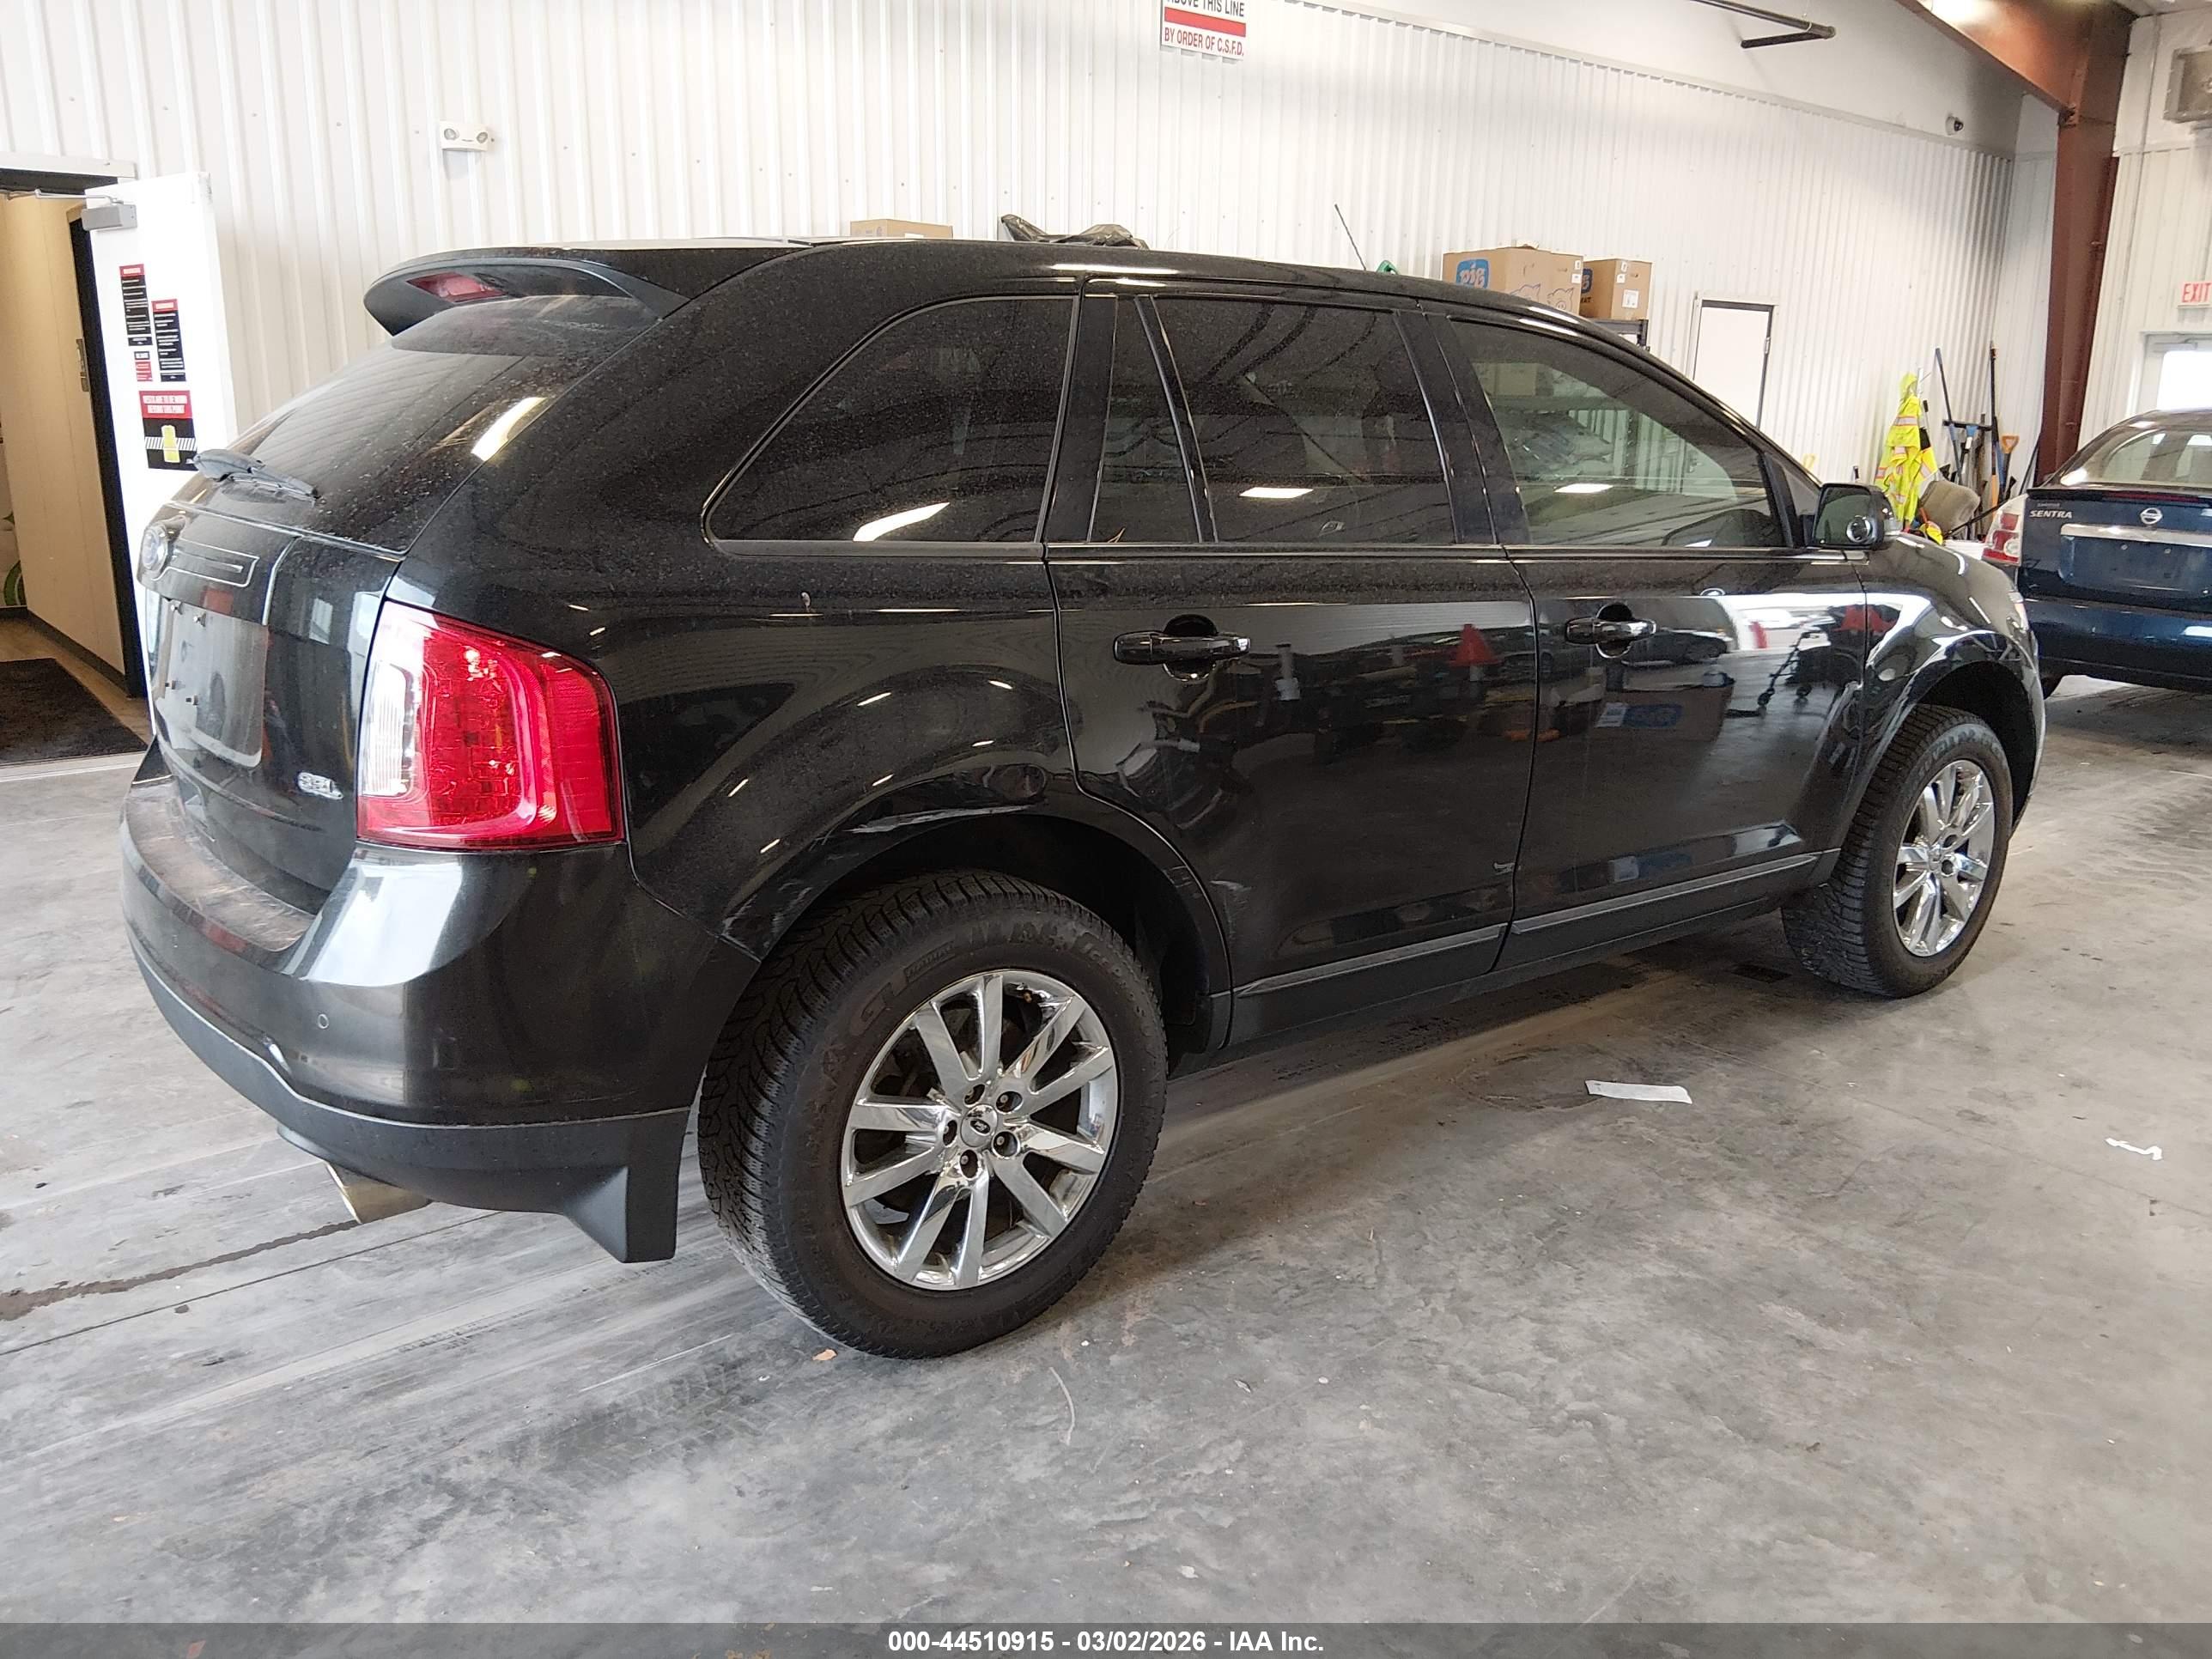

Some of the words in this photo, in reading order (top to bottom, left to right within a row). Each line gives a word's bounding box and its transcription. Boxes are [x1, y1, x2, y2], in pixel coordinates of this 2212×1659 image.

[1203, 0, 1222, 12] THIS
[1224, 0, 1244, 16] LINE
[1164, 27, 1175, 43] BY
[1177, 30, 1202, 48] ORDER
[1206, 35, 1215, 51] OF
[1217, 38, 1244, 56] C.S.F.D.
[2182, 283, 2212, 302] EXIT
[2029, 509, 2073, 519] SENTRA
